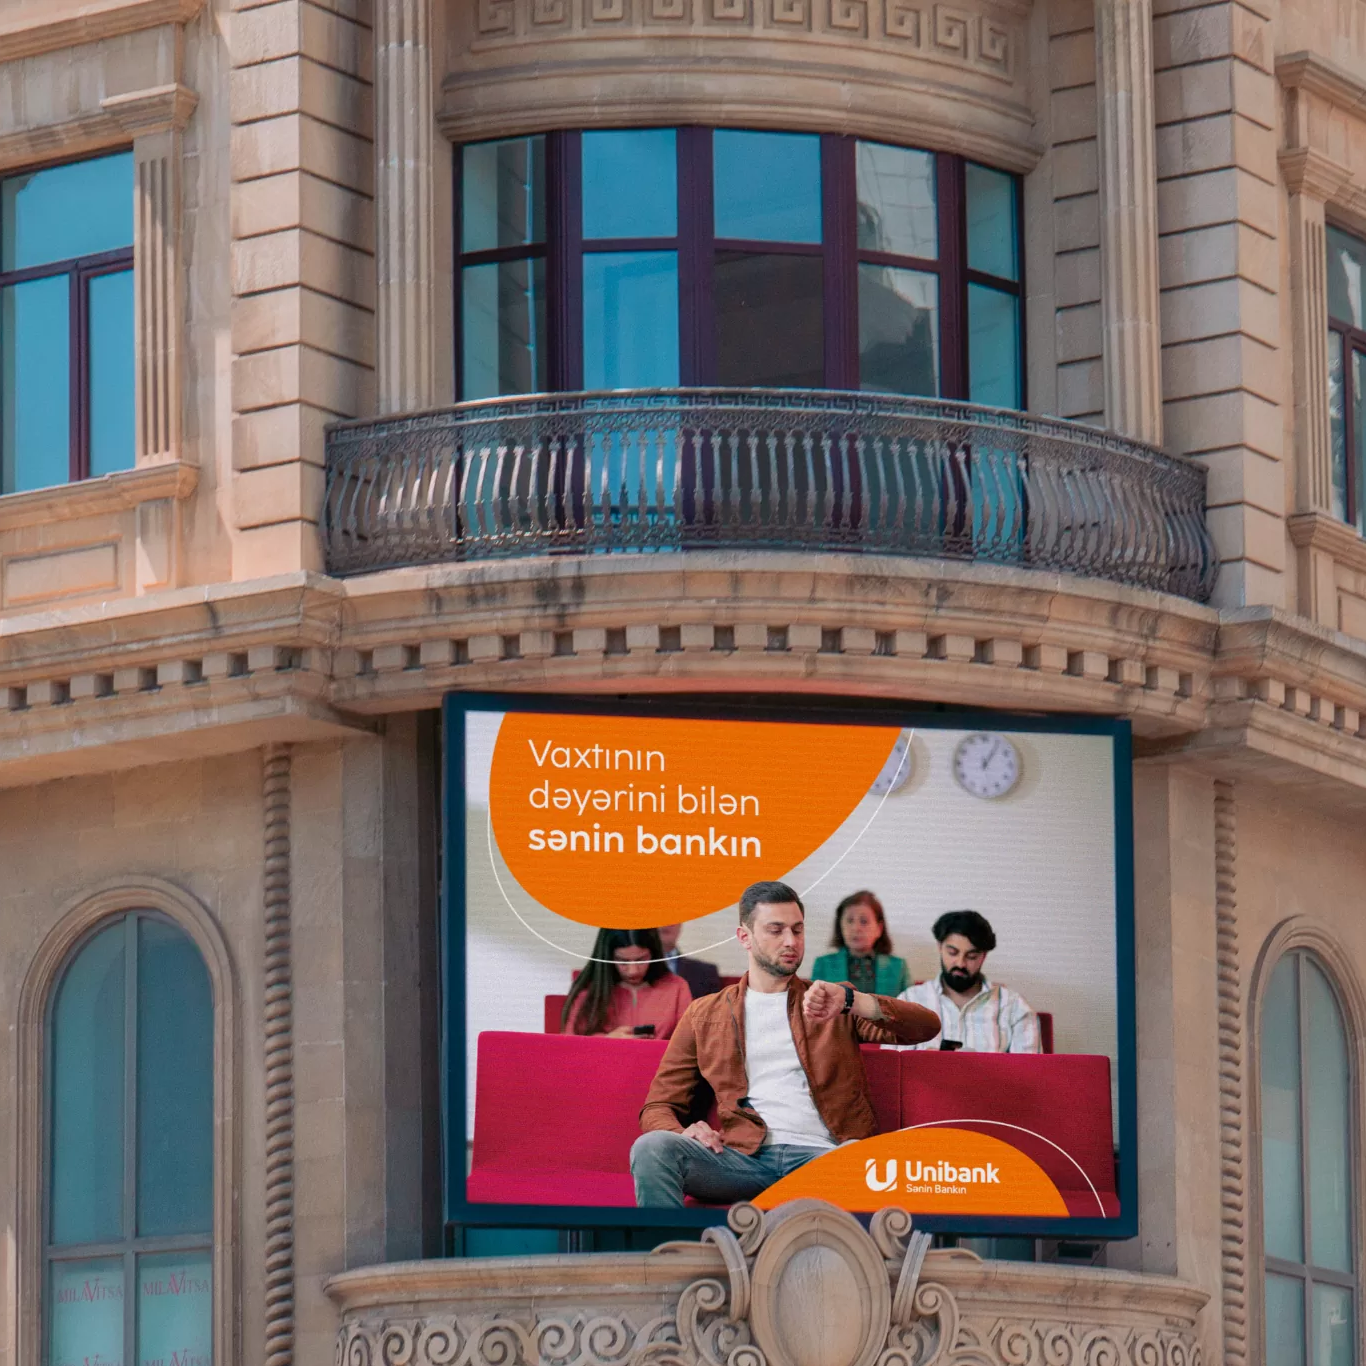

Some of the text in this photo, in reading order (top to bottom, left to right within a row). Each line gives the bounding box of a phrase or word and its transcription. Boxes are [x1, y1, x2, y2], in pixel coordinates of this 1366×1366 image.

[528, 739, 665, 771] Vaxtının
[528, 780, 760, 816] dəyərini bilən
[528, 823, 762, 858] sənin bankın
[905, 1160, 1001, 1184] Unibank
